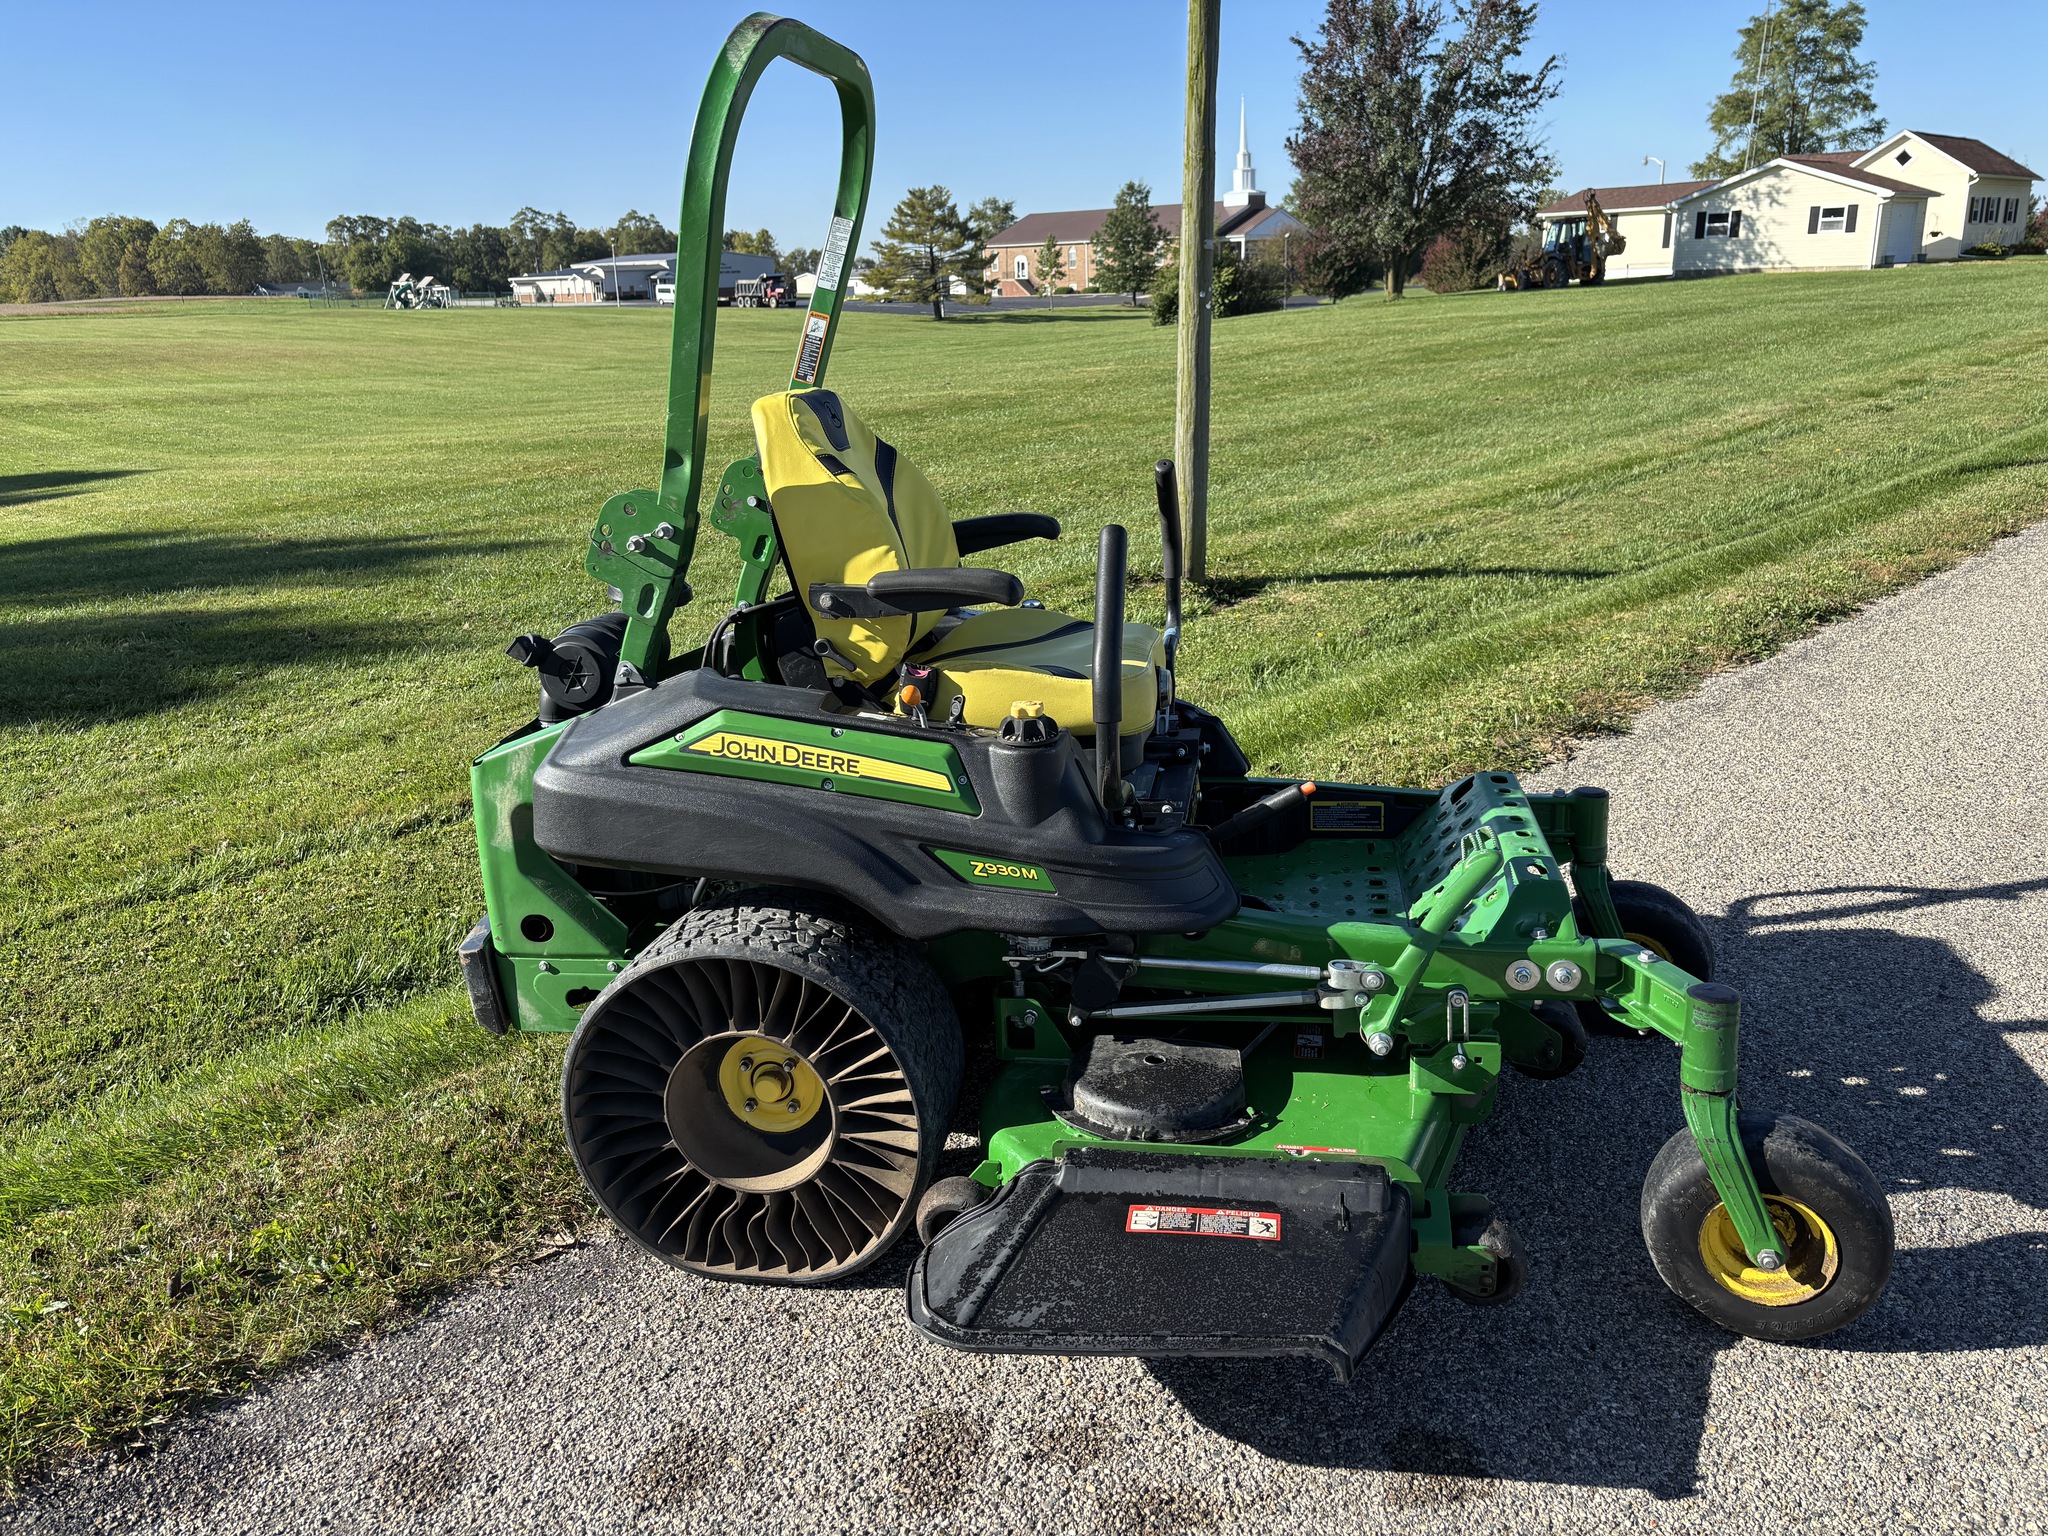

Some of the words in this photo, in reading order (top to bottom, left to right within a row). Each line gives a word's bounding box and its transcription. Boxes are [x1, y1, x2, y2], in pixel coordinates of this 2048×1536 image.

[711, 735, 777, 759] JOHN
[783, 744, 861, 775] DEERE
[969, 860, 1039, 881] Z930M
[1155, 1205, 1187, 1213] DANGER
[1225, 1209, 1260, 1218] PELIGRO
